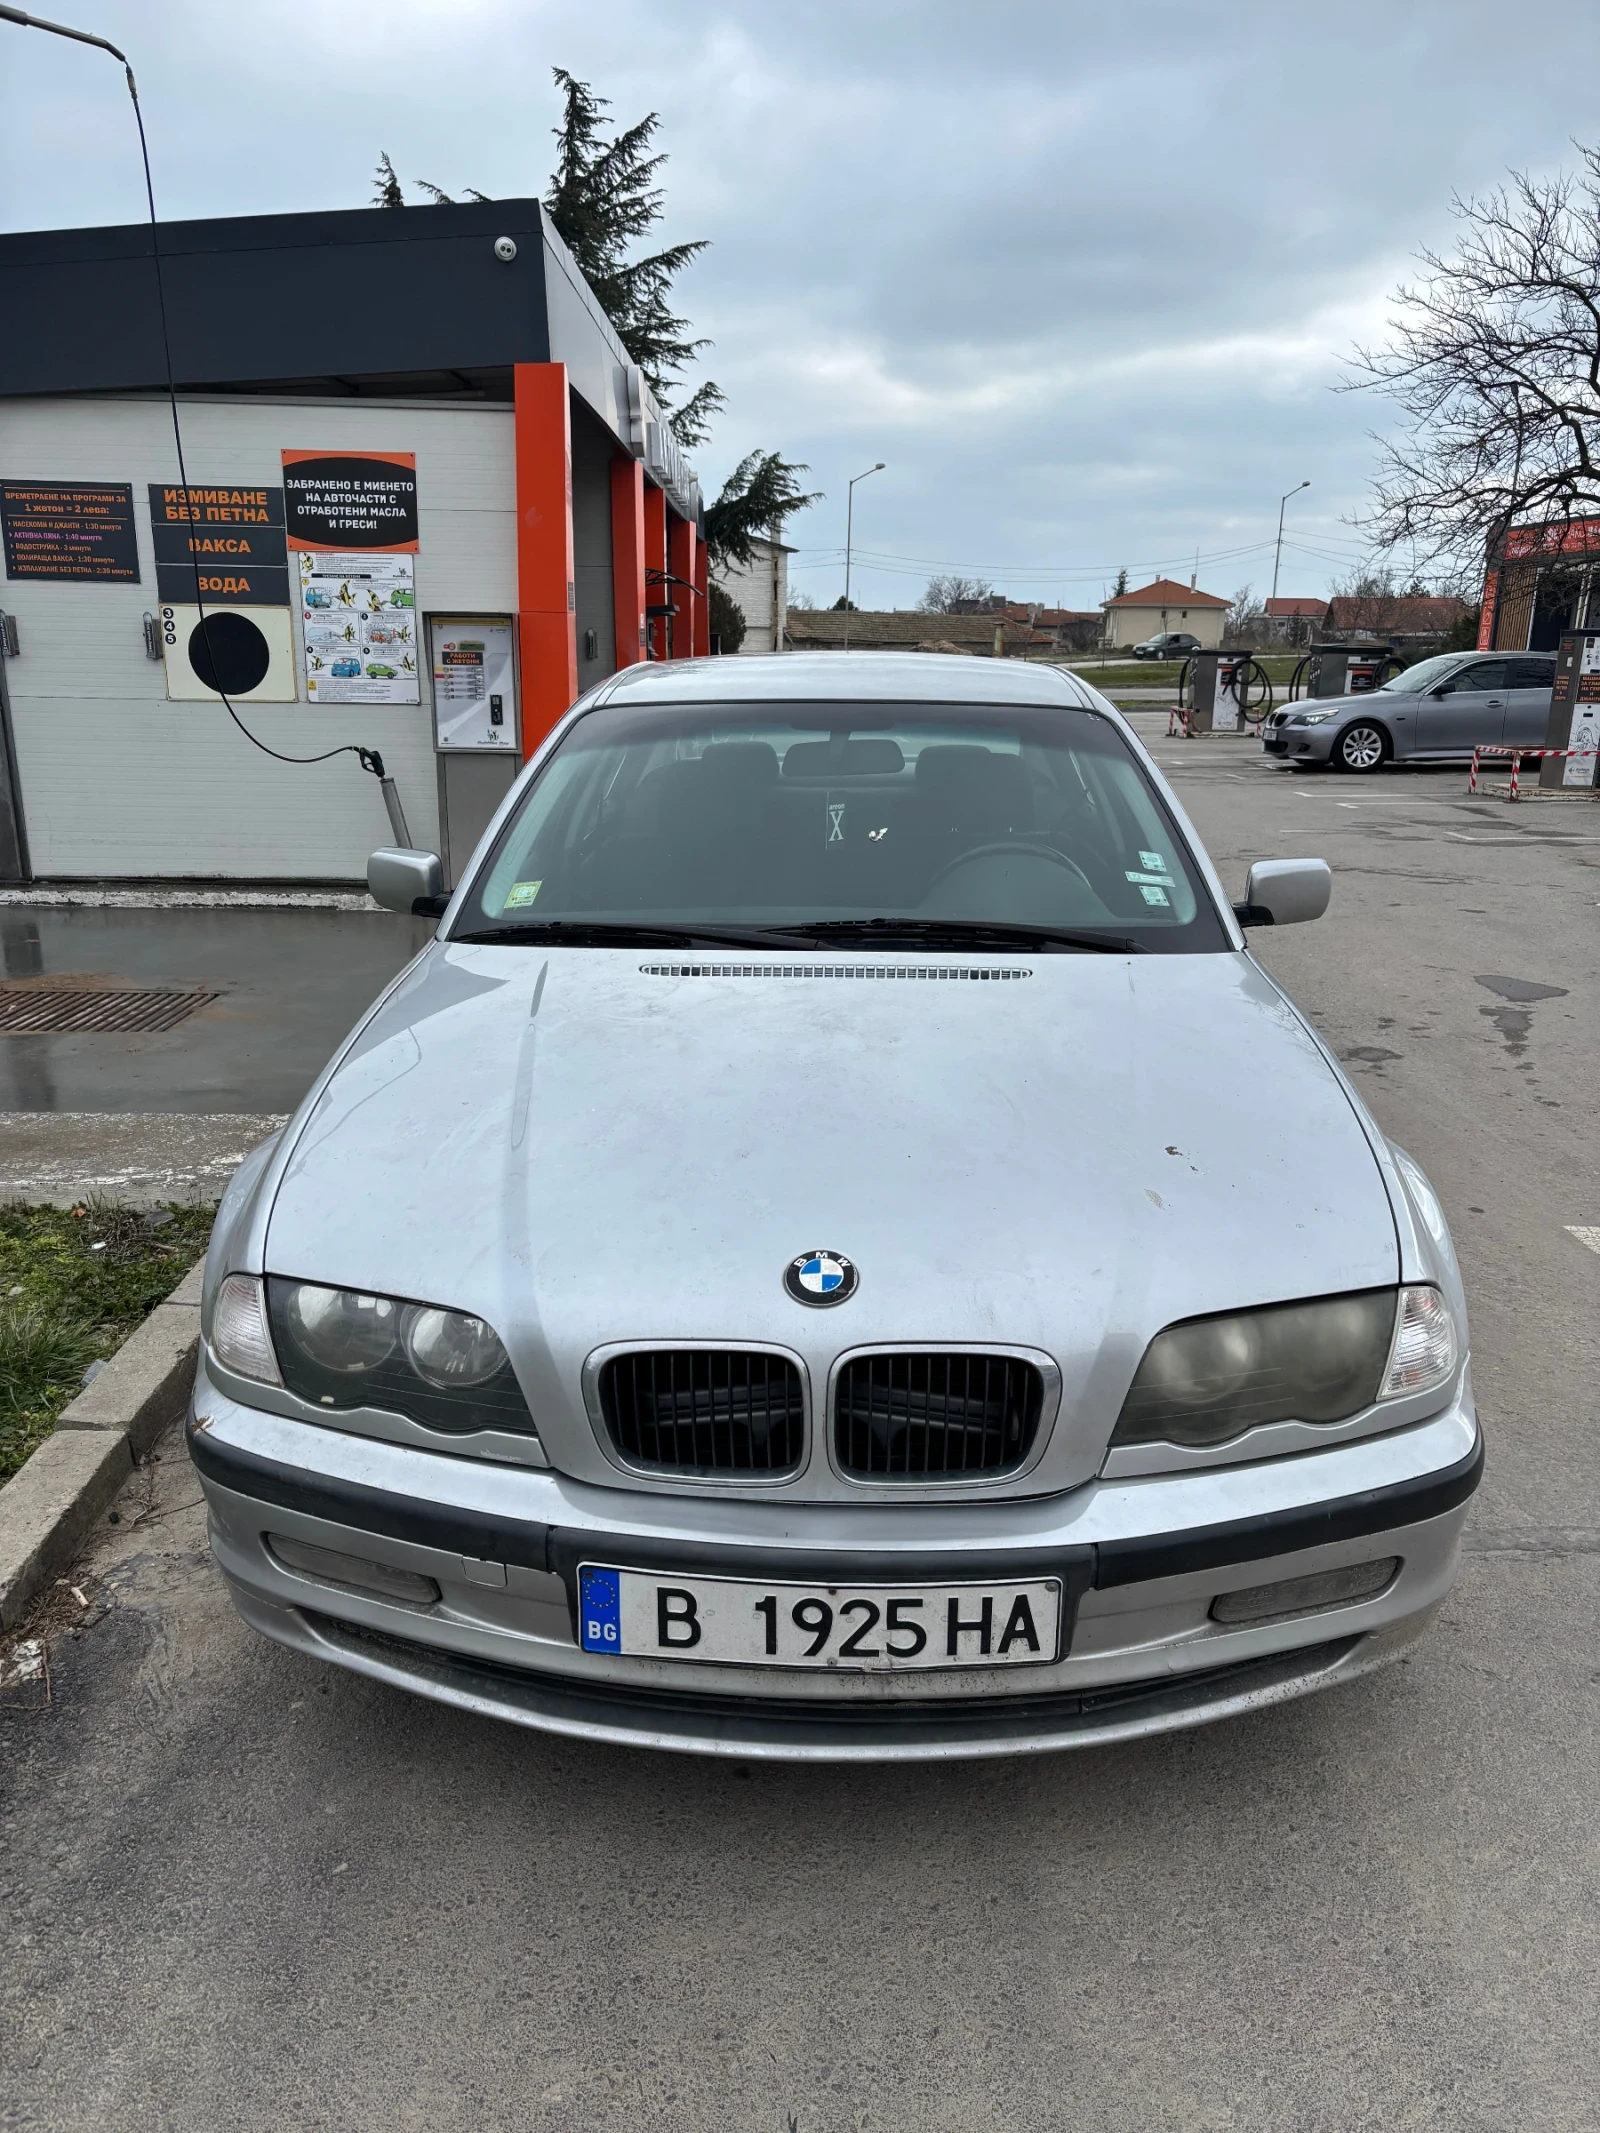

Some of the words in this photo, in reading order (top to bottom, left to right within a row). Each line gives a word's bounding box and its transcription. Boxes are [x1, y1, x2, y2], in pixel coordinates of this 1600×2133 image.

[287, 479, 350, 490] ЗАБРАНЕНО
[354, 481, 361, 490] Е
[364, 482, 414, 491] МИЕНЕТО
[164, 489, 268, 505] ИЗМИВАНЕ
[306, 493, 321, 502] НА
[324, 494, 386, 503] АВТОЧАСТИ
[390, 495, 396, 503] С
[166, 506, 200, 520] БЕЗ
[207, 507, 269, 522] ПЕТНА
[298, 506, 367, 516] ОТРАБОТЕНИ
[371, 508, 407, 517] МАСЛА
[329, 520, 336, 528] И
[340, 520, 377, 529] ГРЕСИ!
[16, 543, 59, 551] ВОДОСТРУЙКА
[189, 538, 251, 553] ВАКСА
[198, 577, 251, 593] ВОДА
[828, 810, 844, 841] X
[794, 1252, 850, 1267] BMW
[657, 1587, 701, 1648] B
[755, 1595, 927, 1658] 1925
[947, 1594, 1040, 1656] HA
[588, 1620, 616, 1642] BG
